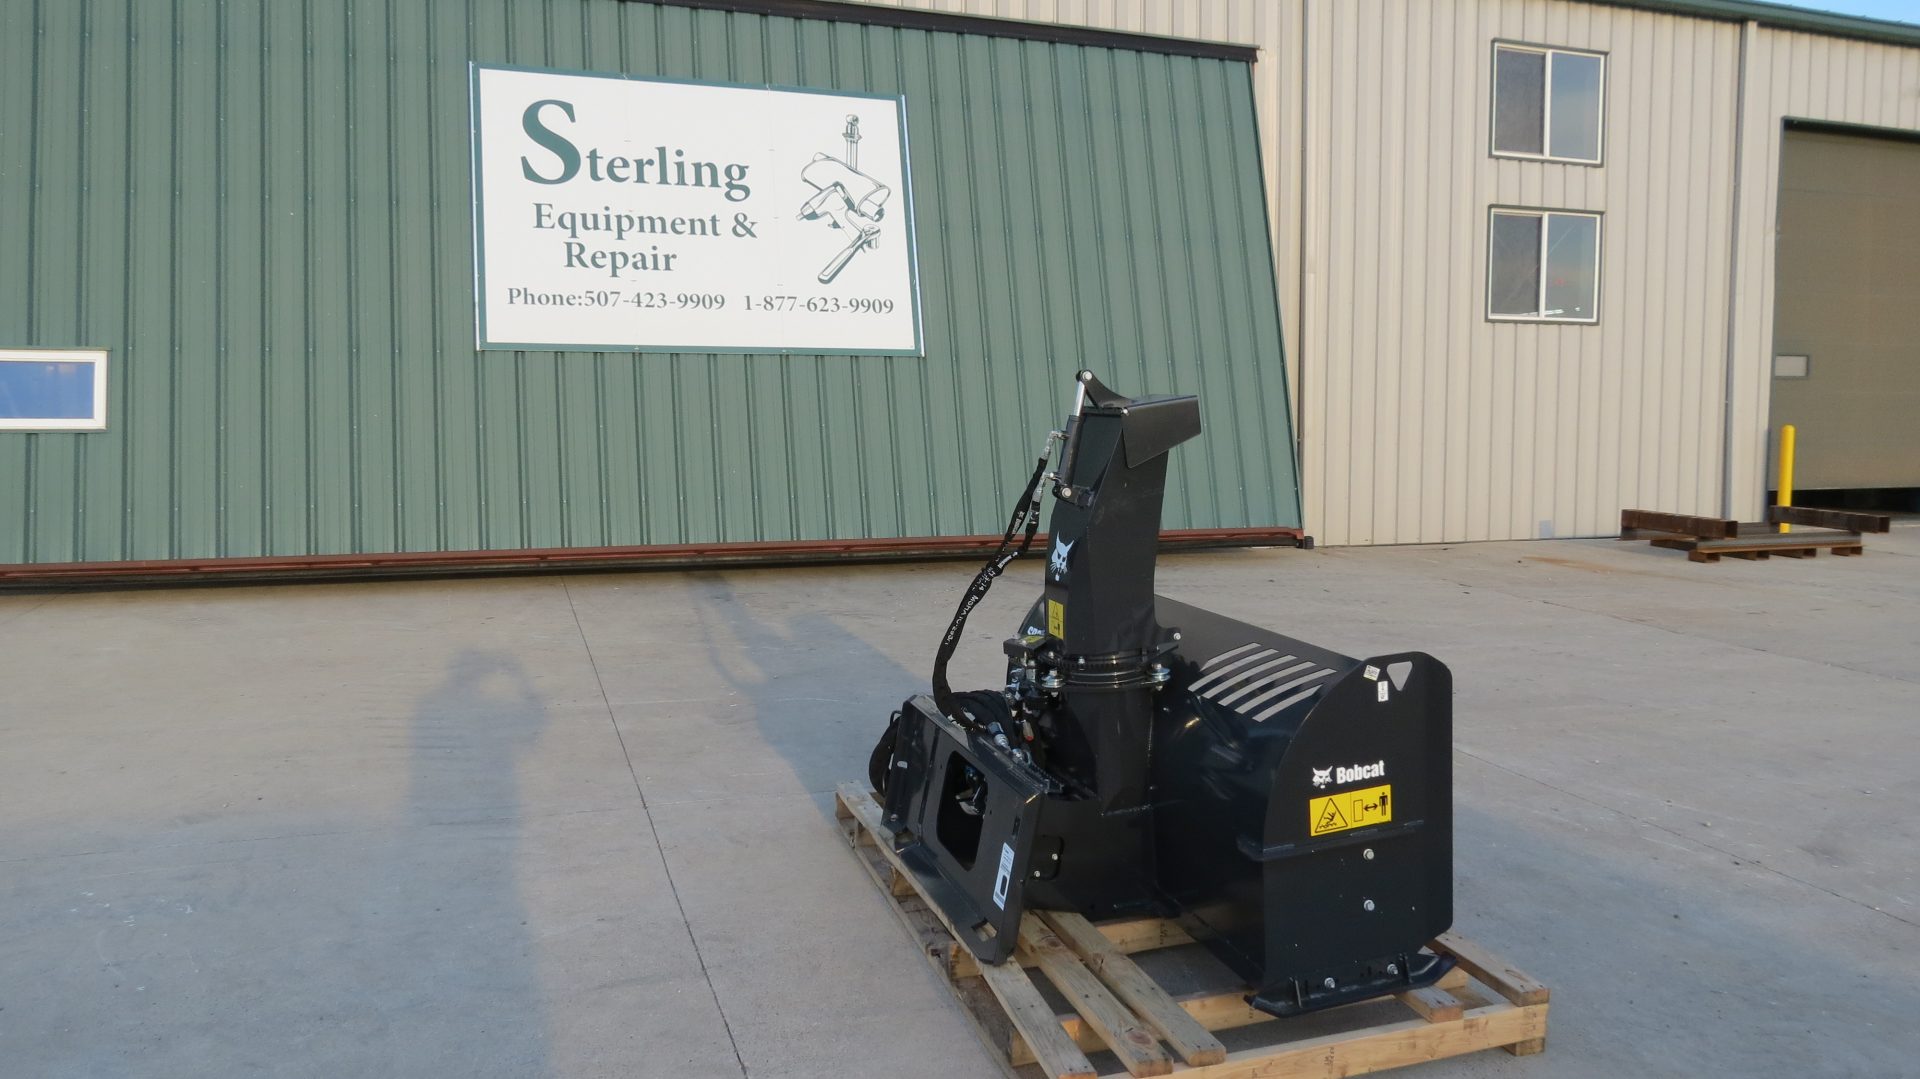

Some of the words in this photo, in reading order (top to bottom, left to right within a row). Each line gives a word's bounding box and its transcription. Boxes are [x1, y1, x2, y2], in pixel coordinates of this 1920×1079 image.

[521, 99, 751, 203] Sterling
[534, 203, 721, 240] Equipment
[732, 213, 758, 239] &
[564, 241, 678, 278] Repair
[508, 287, 726, 310] Phone:507-423-9909
[745, 295, 894, 314] 1-877-623-9909
[1336, 760, 1385, 785] Bobcat
